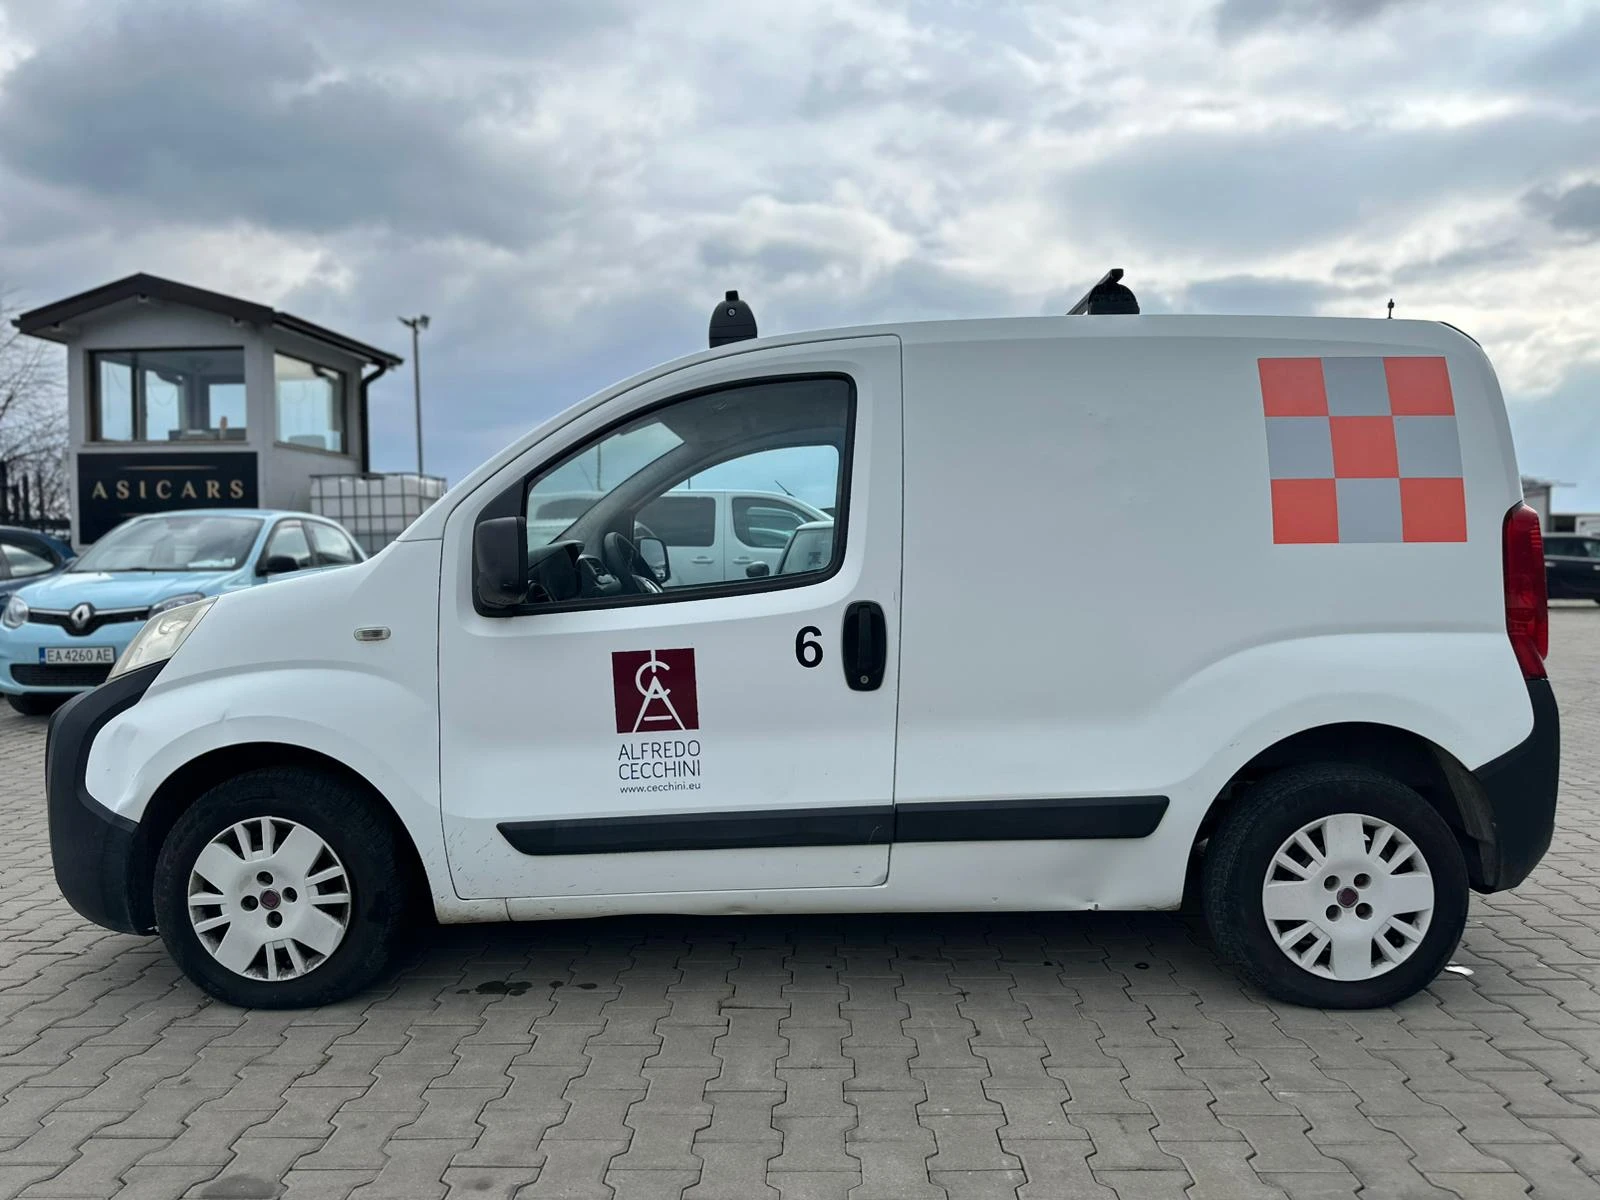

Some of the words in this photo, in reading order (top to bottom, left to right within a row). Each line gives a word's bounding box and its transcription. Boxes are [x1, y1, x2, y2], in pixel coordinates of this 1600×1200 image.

[92, 479, 245, 499] ASICARS
[47, 649, 62, 662] EA
[64, 649, 93, 662] 4260
[96, 648, 111, 662] AE
[795, 625, 824, 668] 6
[618, 740, 701, 761] ALFREDO
[618, 760, 701, 780] CECCHINI
[620, 782, 701, 794] www.cecchini.eu
